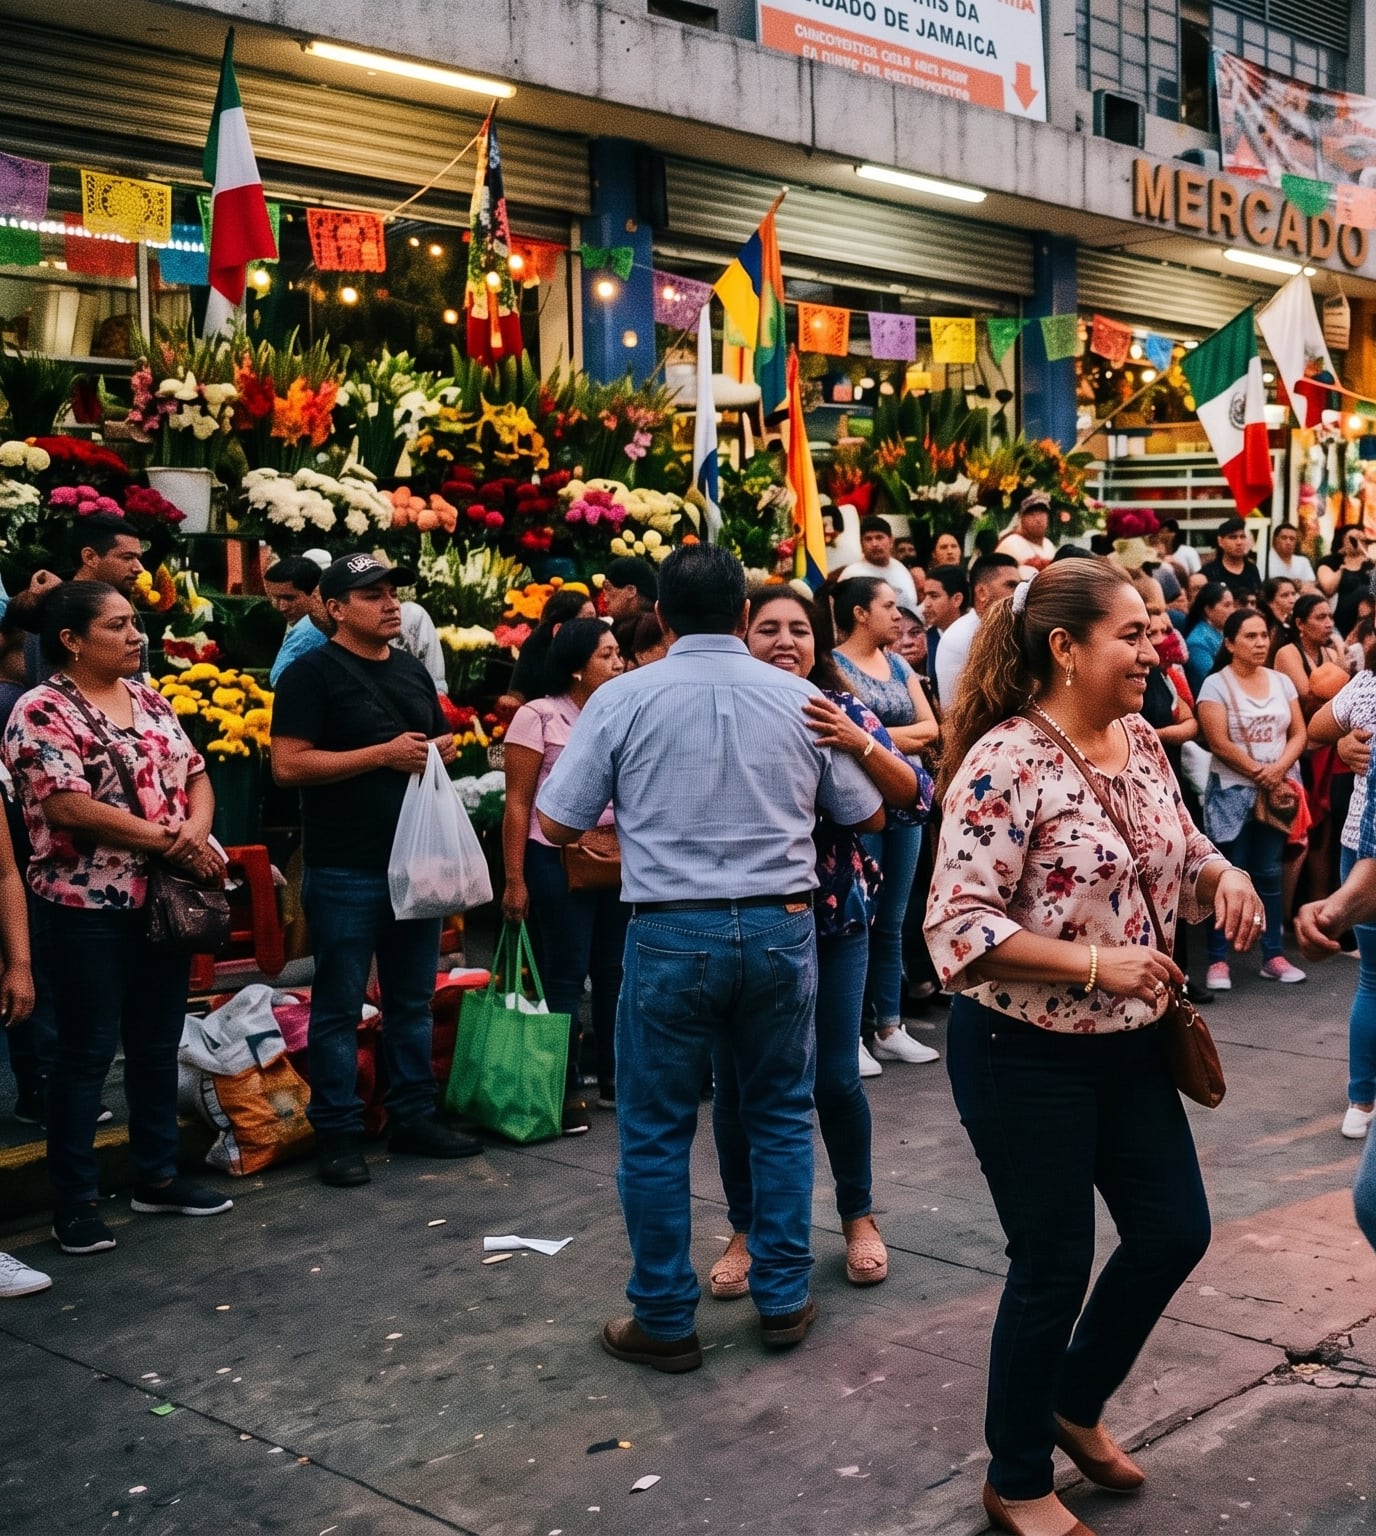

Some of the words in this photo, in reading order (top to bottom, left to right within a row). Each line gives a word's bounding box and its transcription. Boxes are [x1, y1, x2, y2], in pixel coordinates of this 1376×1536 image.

[884, 8, 909, 33] DE
[916, 19, 998, 60] JAMAICA
[1134, 158, 1369, 269] MERCADO
